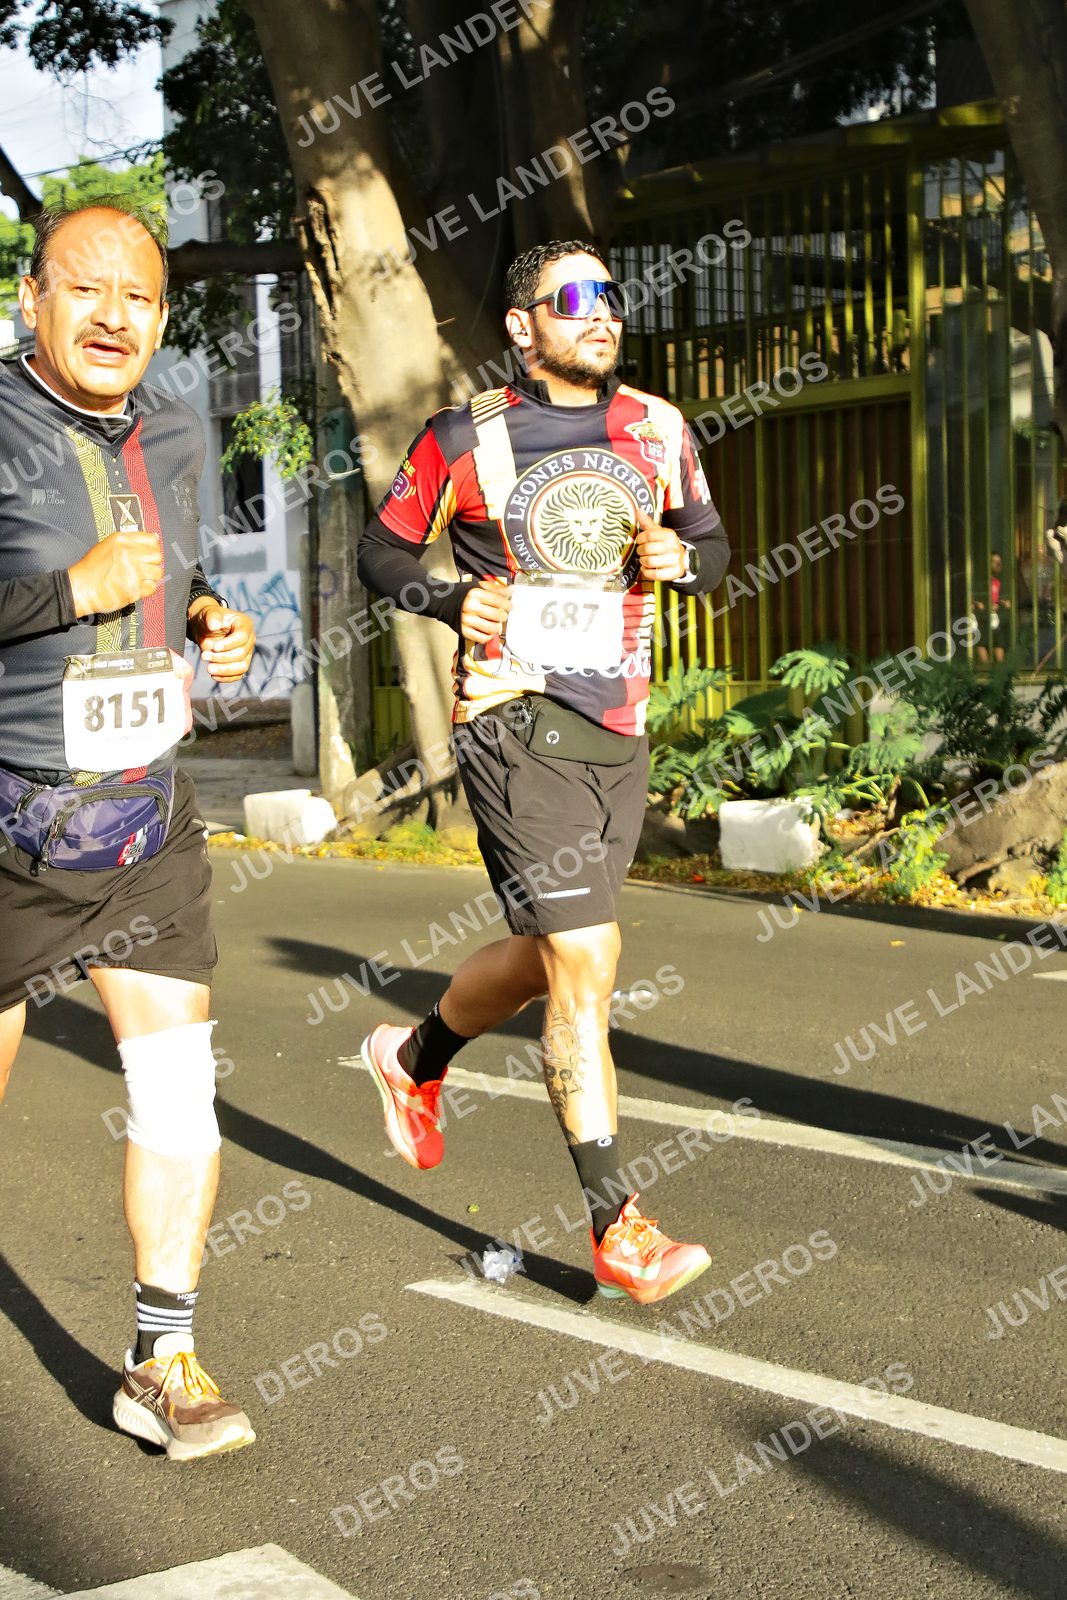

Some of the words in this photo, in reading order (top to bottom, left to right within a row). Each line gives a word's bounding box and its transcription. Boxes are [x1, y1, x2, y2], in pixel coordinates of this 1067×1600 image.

[508, 454, 576, 521] LEONES
[583, 452, 654, 516] NEGROS
[514, 533, 542, 570] UNIVE
[540, 600, 600, 632] 687
[84, 687, 165, 732] 8151
